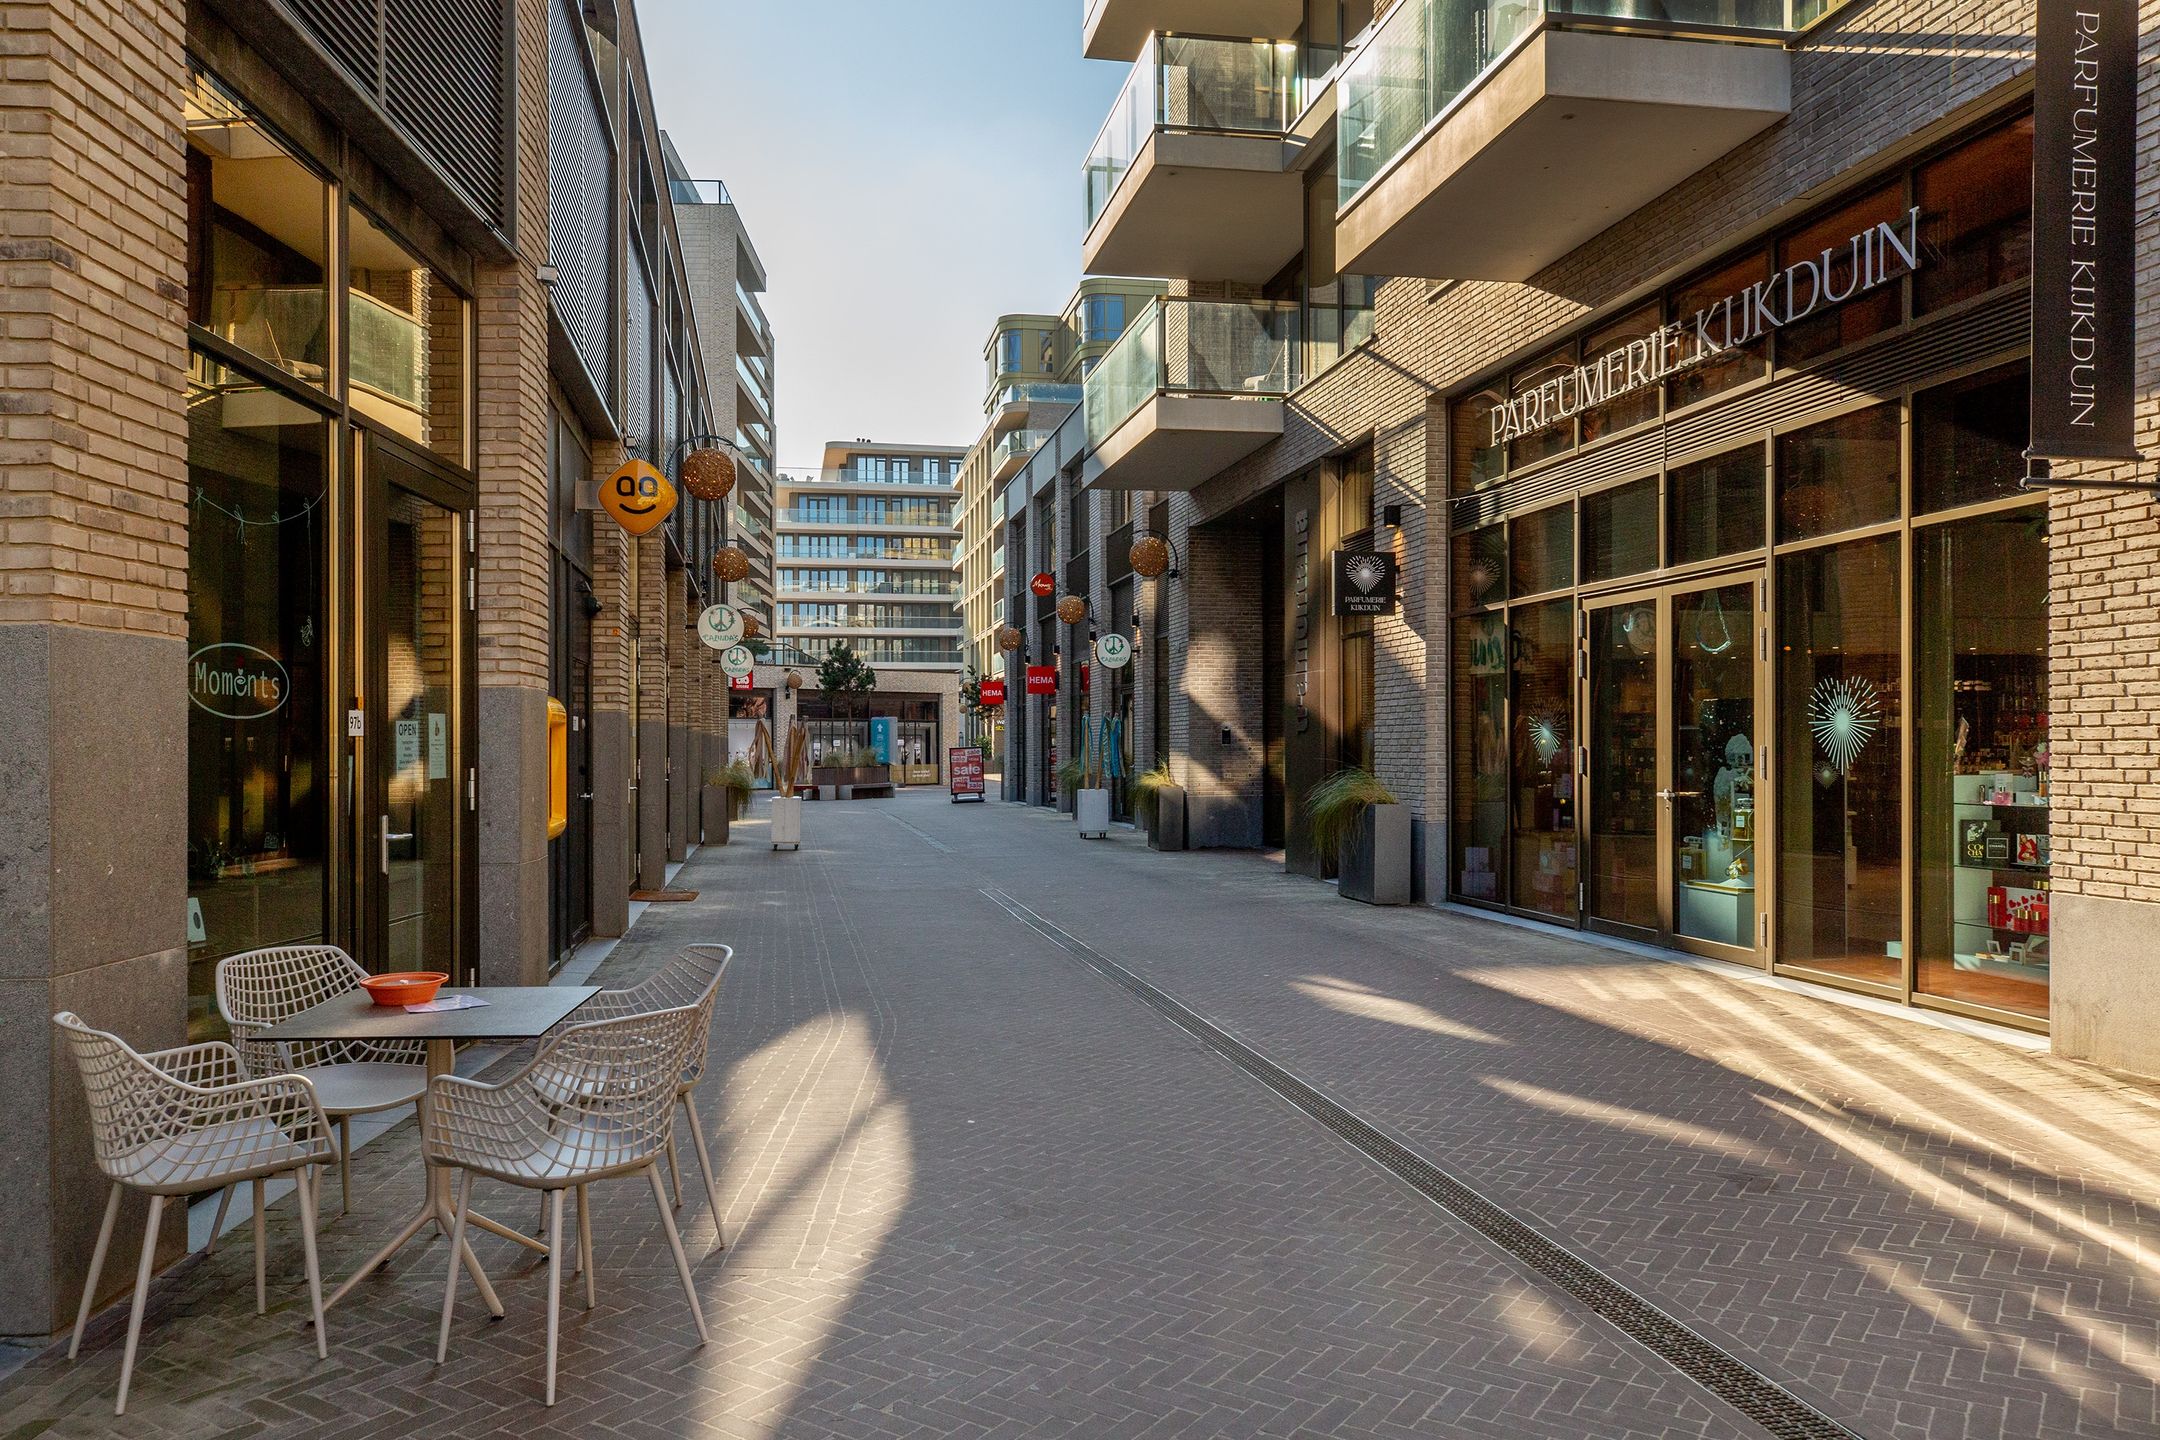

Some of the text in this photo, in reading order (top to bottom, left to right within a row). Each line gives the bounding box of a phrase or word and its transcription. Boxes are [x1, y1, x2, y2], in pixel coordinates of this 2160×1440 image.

[2069, 11, 2100, 427] PARFUMERIE KIJKDUIN
[1489, 205, 1920, 448] PARFUMERIE KIJKDUIN
[194, 661, 280, 700] Moments
[1029, 676, 1054, 684] HEMA
[349, 715, 362, 730] 97b
[398, 723, 417, 736] OPEN
[953, 763, 980, 775] sale
